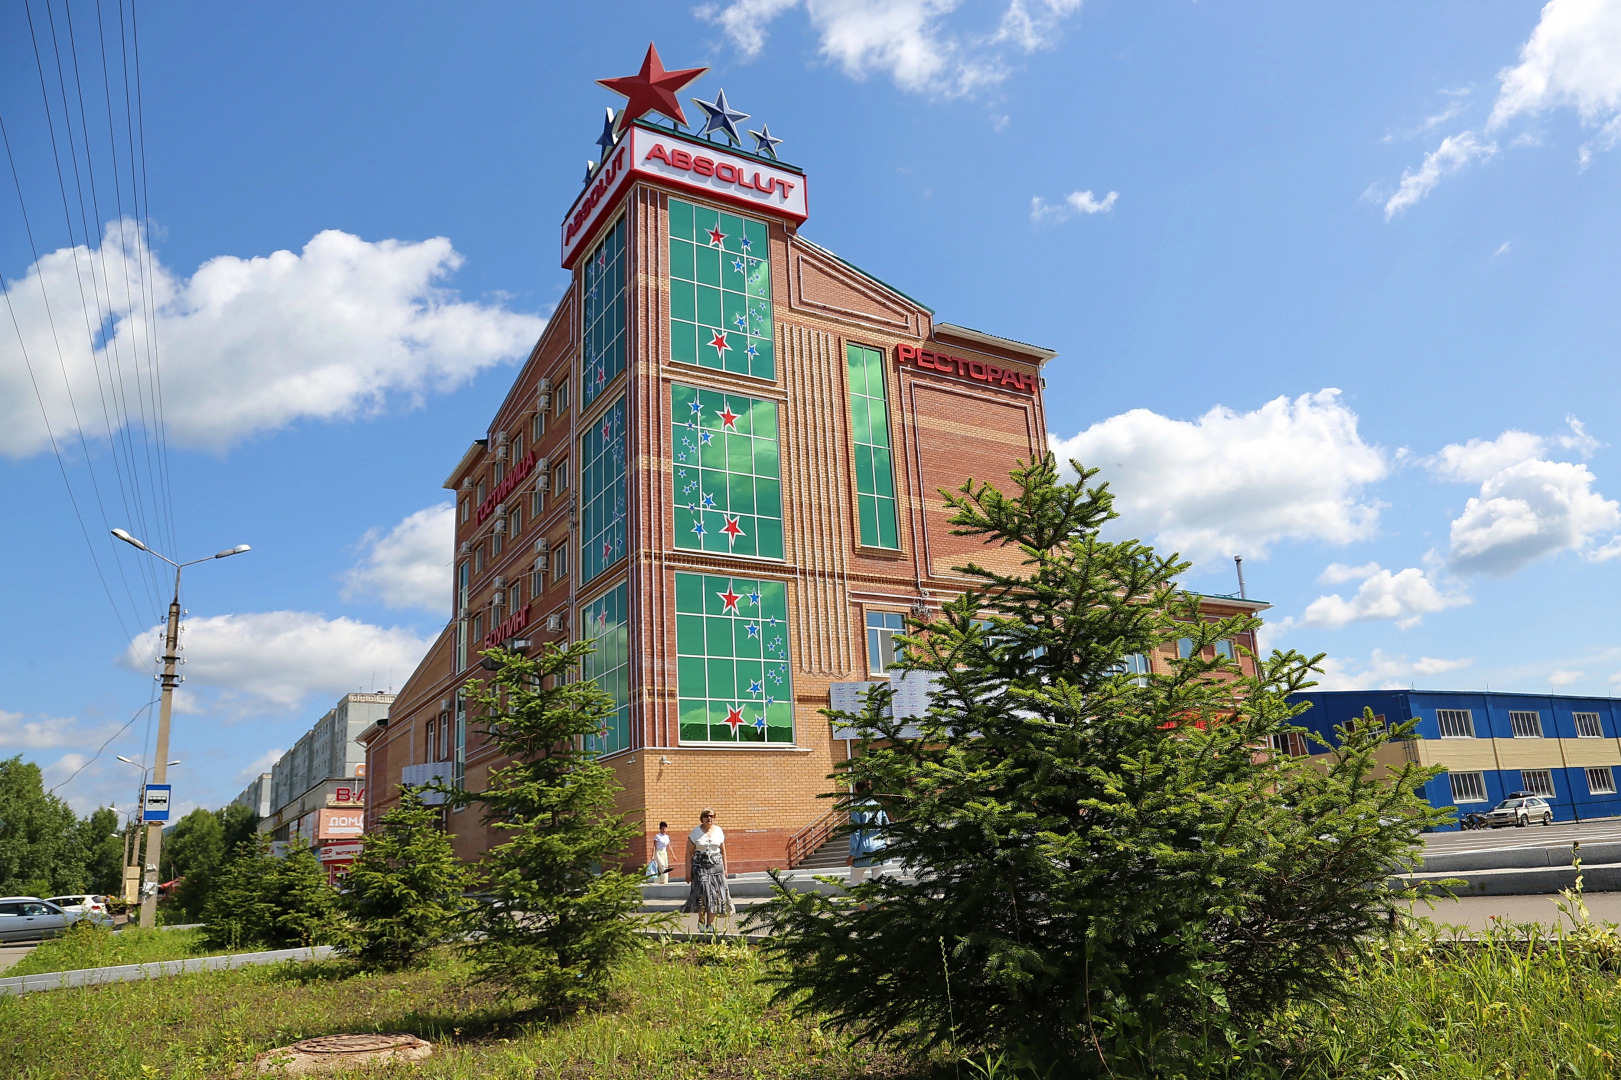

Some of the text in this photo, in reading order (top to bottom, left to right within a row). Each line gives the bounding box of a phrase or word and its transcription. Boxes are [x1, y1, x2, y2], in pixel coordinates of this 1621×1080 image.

[564, 146, 626, 246] ABSOLUT
[646, 143, 795, 199] ABSOLUT
[897, 343, 1037, 392] РЕСТОРАН
[475, 450, 536, 526] ГОСТИНИЦА
[484, 603, 532, 651] БОУЛИНГ
